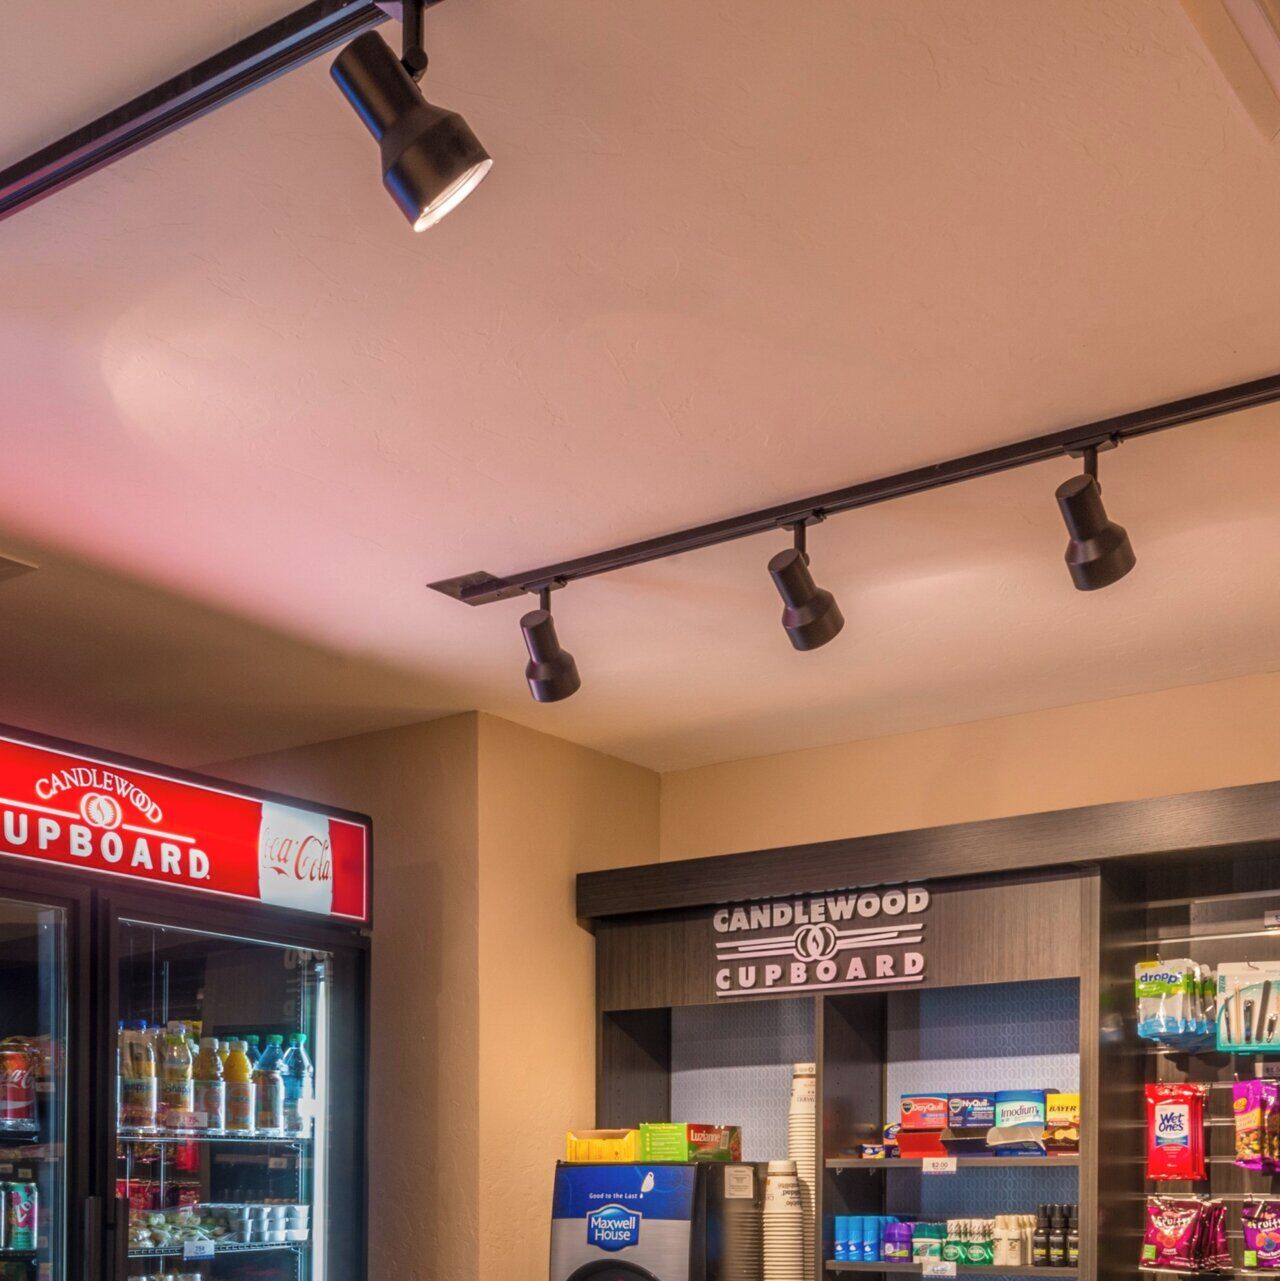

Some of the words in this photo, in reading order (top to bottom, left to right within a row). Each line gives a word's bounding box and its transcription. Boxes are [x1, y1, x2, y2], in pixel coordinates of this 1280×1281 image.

[35, 768, 163, 824] CANDLEWOOD
[713, 887, 930, 934] CANDLEWOOD
[716, 951, 925, 991] CUPBOARD
[913, 1102, 945, 1112] DayQuil
[962, 1098, 990, 1110] NyQuil
[1001, 1105, 1038, 1119] Imodium
[1048, 1105, 1078, 1113] BAYER
[1159, 1112, 1185, 1124] Wet
[1158, 1121, 1184, 1133] Ones
[690, 1131, 720, 1143] Luzianne
[591, 1216, 636, 1231] Maxwell
[594, 1229, 631, 1241] House
